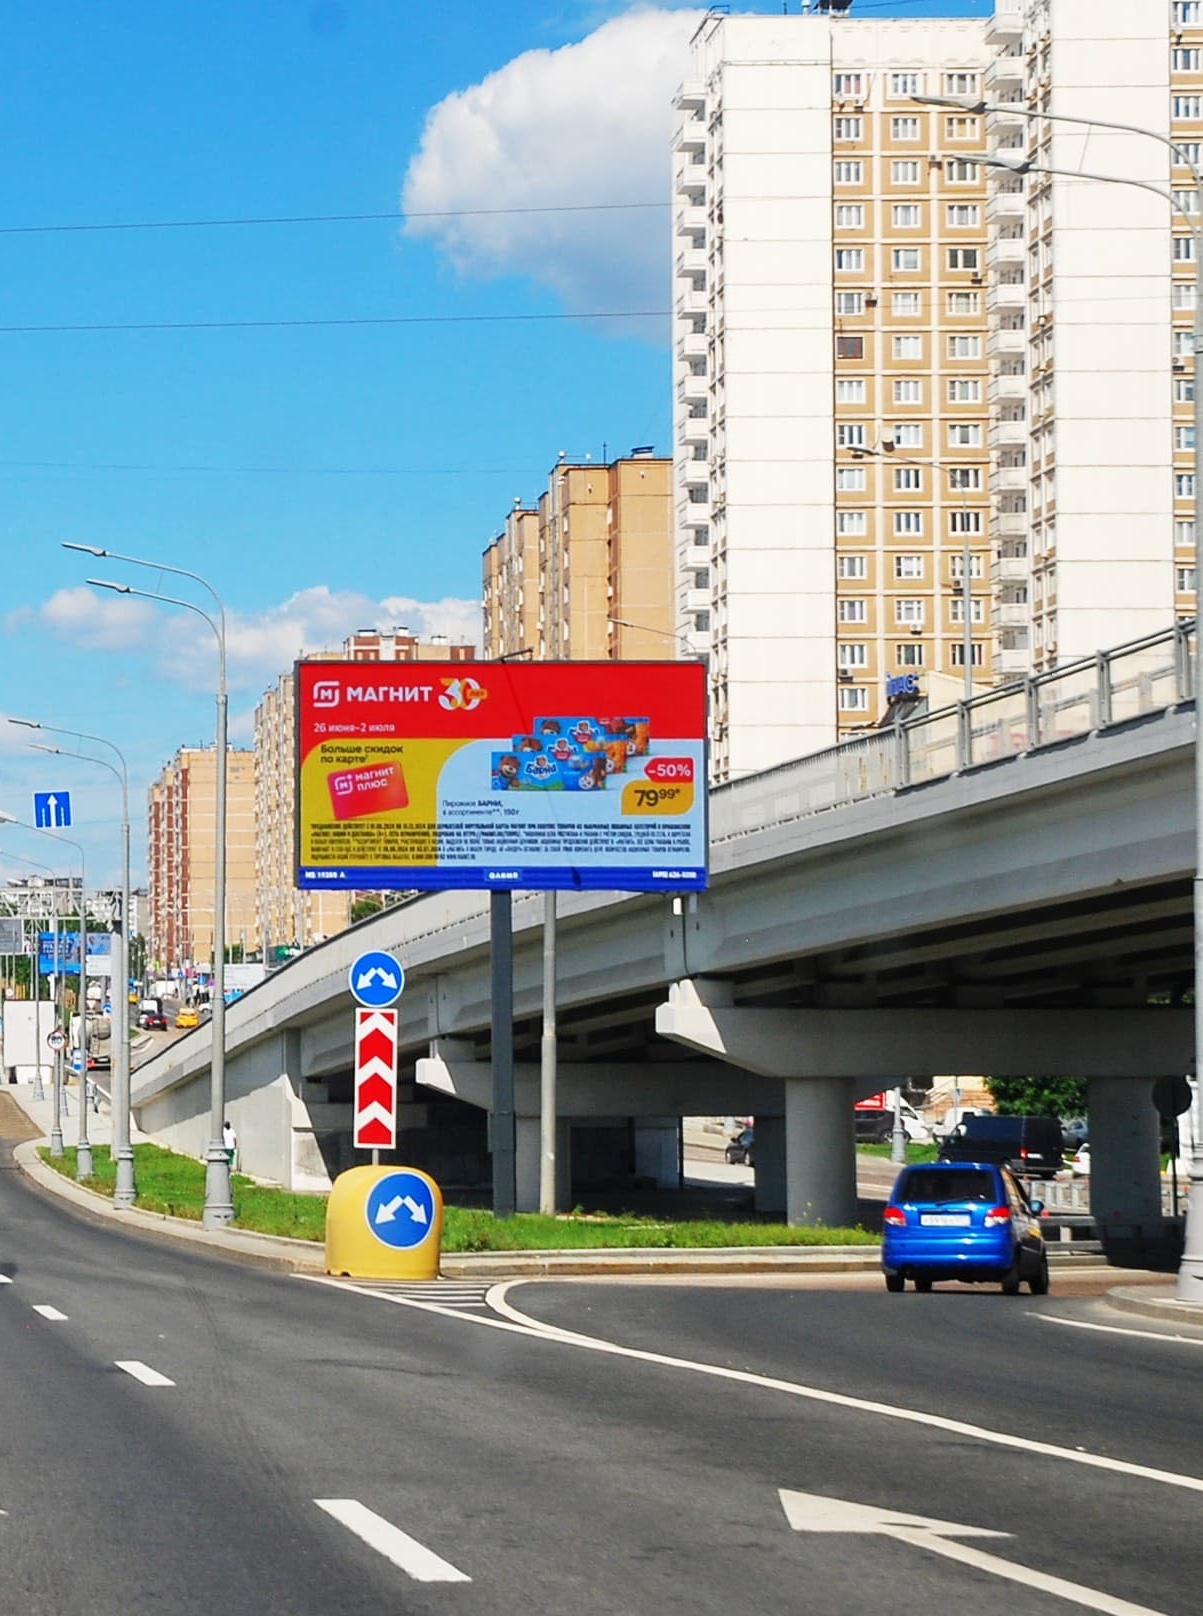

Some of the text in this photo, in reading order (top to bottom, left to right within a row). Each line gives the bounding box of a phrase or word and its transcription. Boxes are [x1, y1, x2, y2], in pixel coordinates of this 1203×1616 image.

[347, 686, 433, 702] МАГНИТ
[438, 677, 482, 711] 30
[313, 723, 326, 733] 26
[369, 723, 395, 733] июля
[321, 744, 404, 755] Больше скидок
[321, 756, 334, 764] по
[647, 764, 692, 777] -50%
